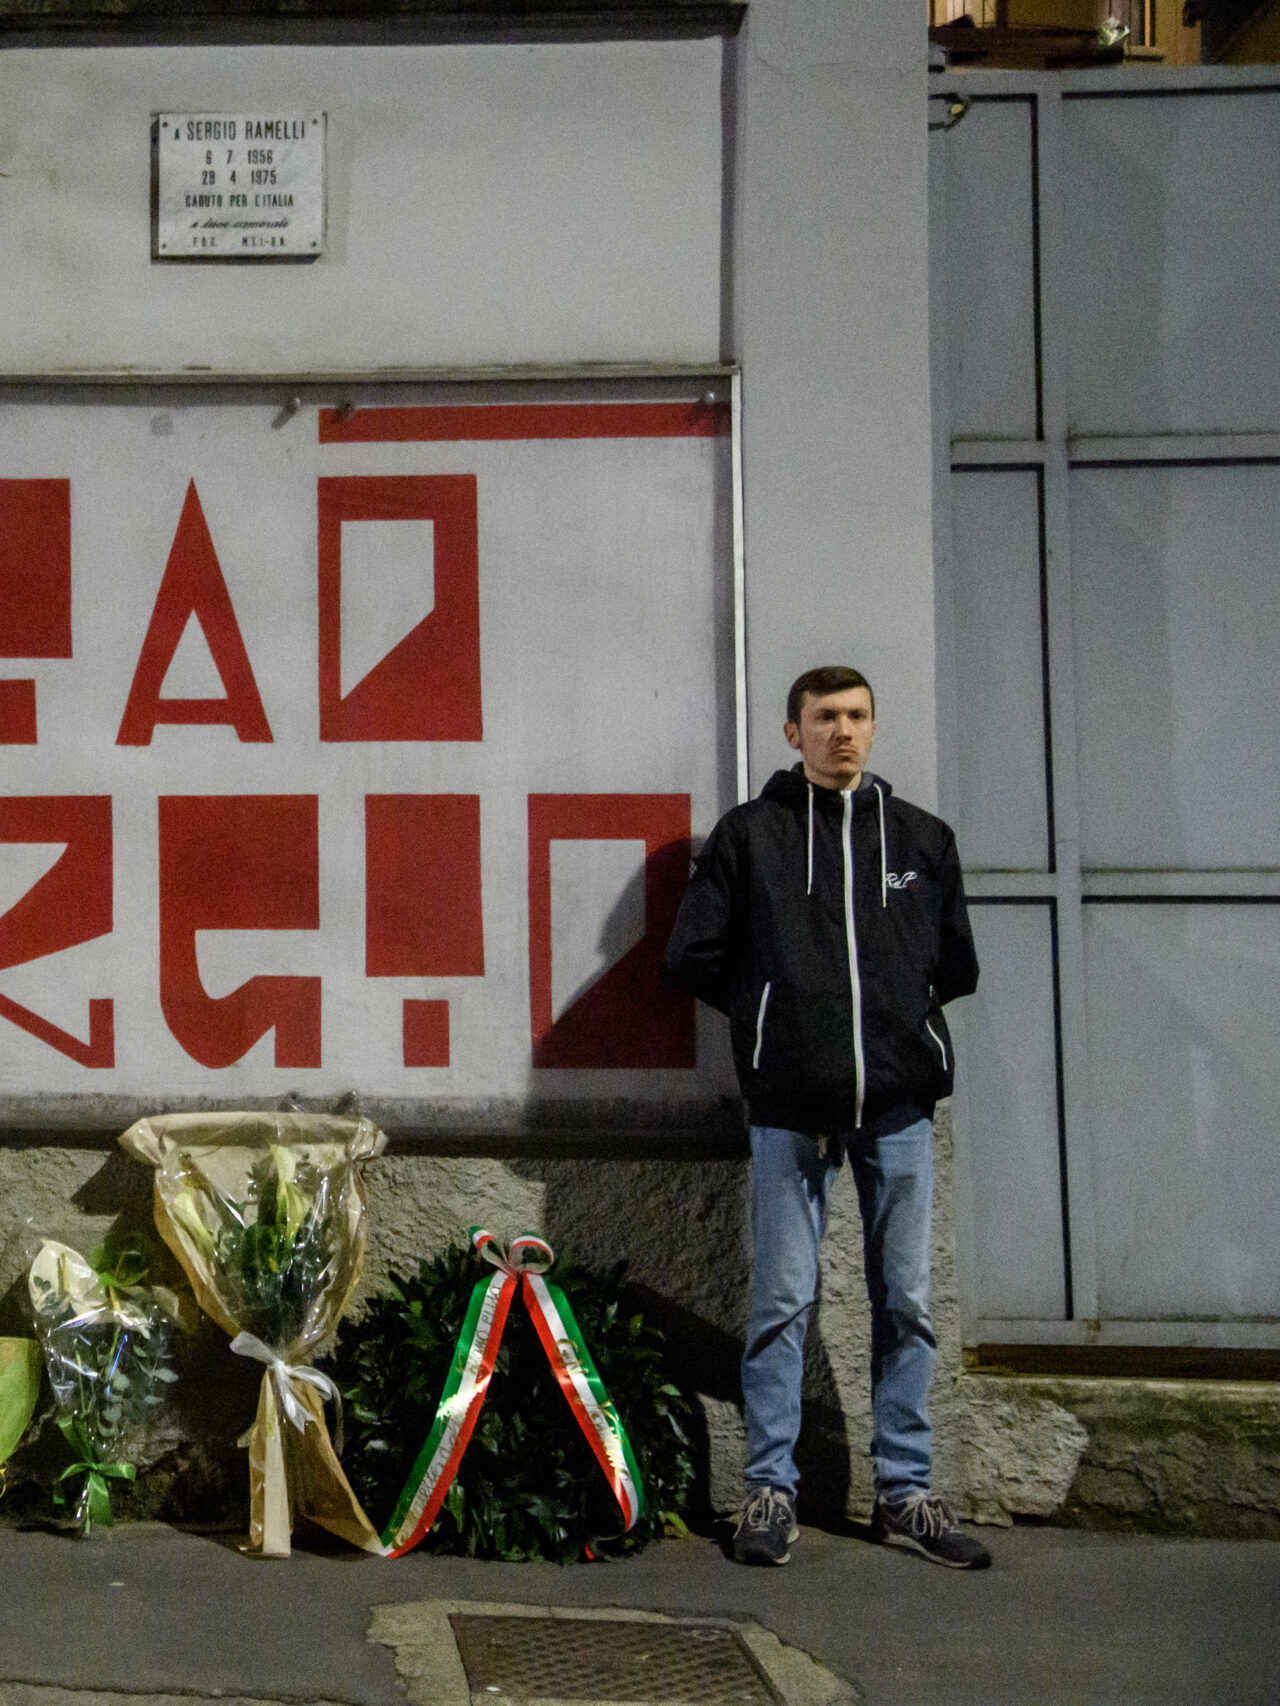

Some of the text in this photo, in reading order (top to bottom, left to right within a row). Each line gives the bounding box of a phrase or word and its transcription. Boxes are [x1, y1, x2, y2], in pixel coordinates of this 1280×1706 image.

[174, 119, 305, 141] A SERGIO RAMELLI
[226, 149, 233, 164] 7
[201, 169, 276, 185] 29 4 1975
[185, 194, 223, 208] CADUTO
[229, 194, 247, 207] PER
